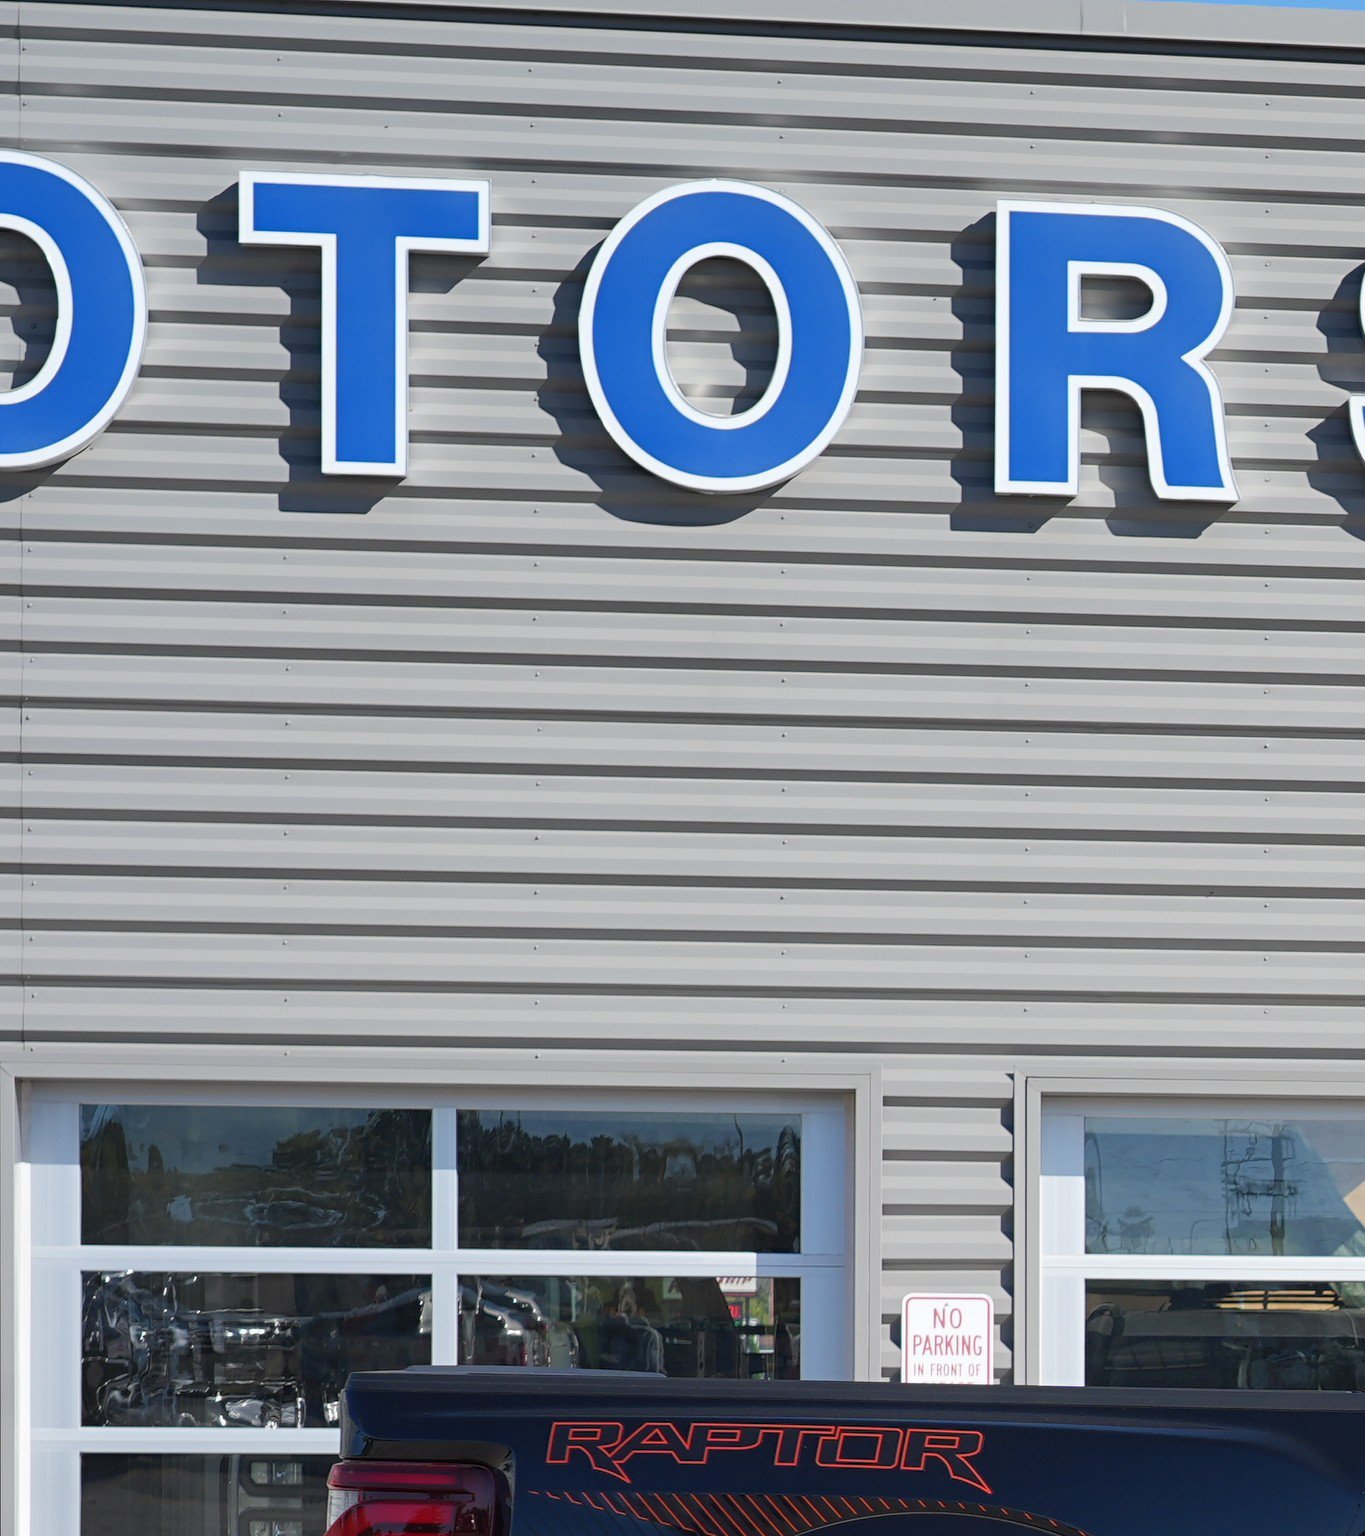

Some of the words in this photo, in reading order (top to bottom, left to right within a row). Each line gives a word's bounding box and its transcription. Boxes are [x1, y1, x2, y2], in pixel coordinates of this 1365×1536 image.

[933, 1308, 962, 1329] NO
[913, 1335, 982, 1356] PARKING
[913, 1363, 924, 1377] IN
[930, 1363, 963, 1377] FRONT
[968, 1363, 981, 1377] OF
[546, 1422, 992, 1494] RAPTOR
